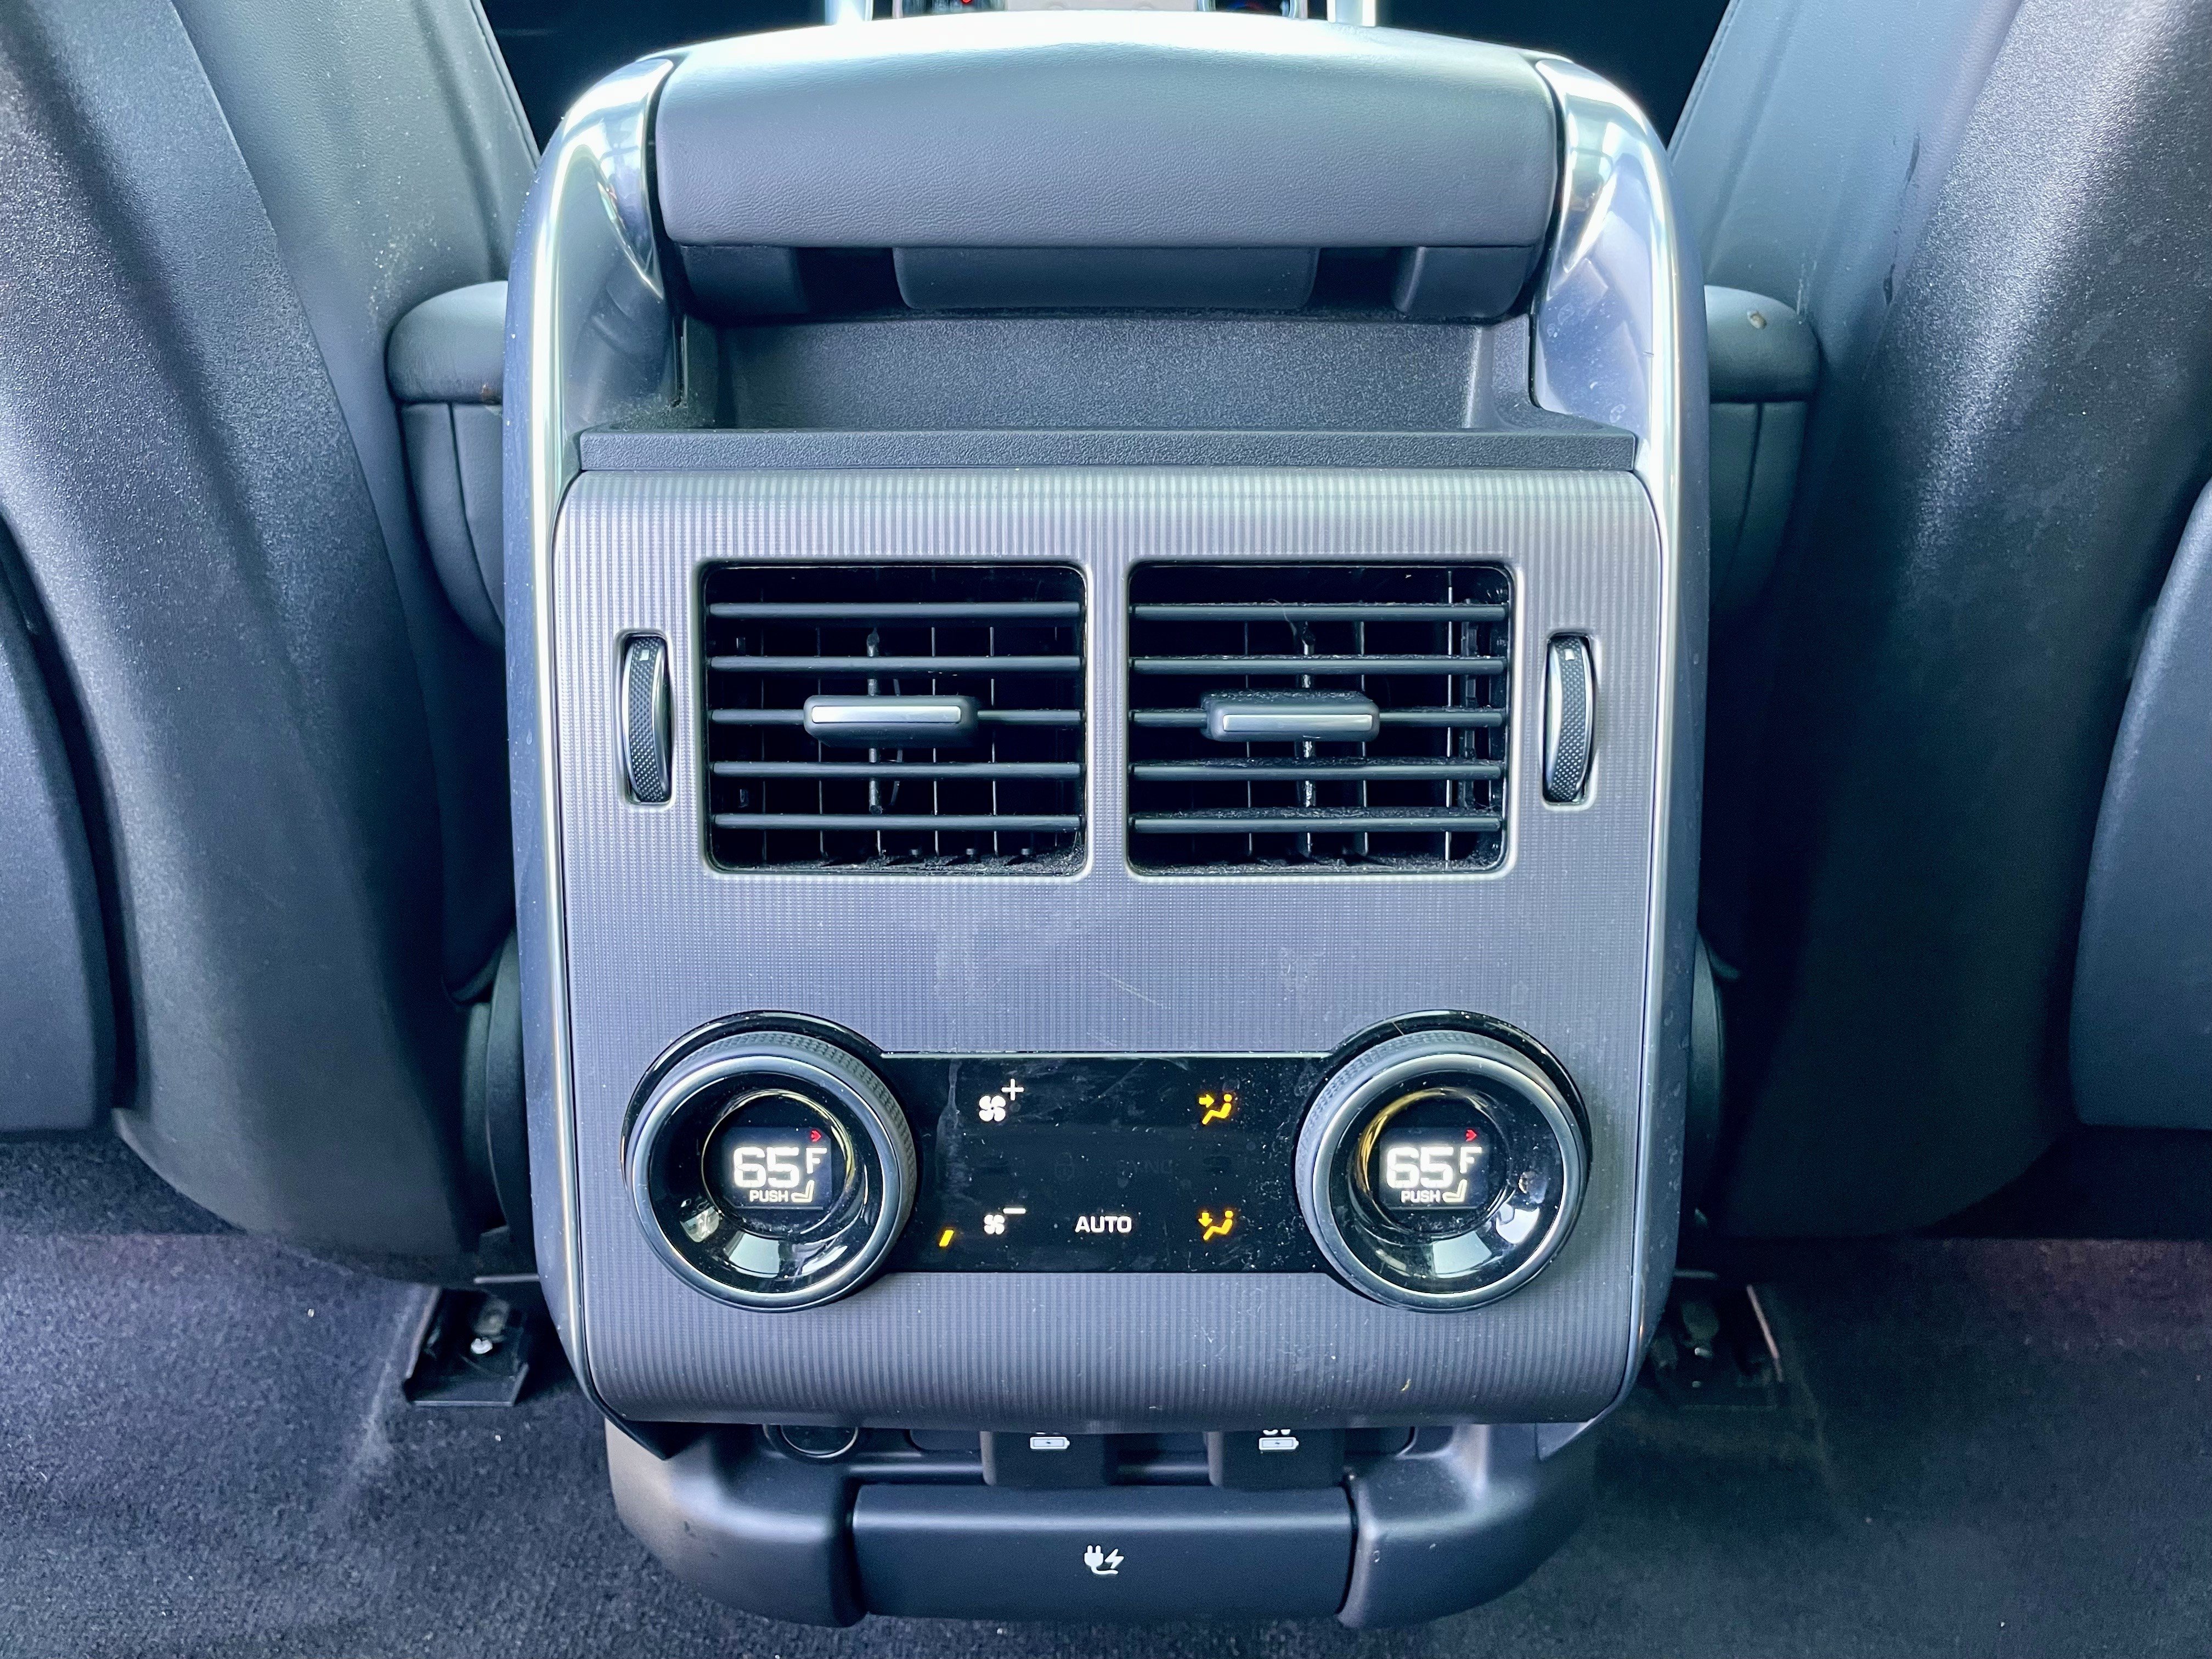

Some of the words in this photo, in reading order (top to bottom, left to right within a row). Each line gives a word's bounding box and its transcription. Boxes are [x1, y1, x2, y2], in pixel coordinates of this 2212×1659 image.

[749, 1189, 789, 1203] PUSH
[1401, 1189, 1441, 1203] PUSH
[1075, 1216, 1132, 1233] AUTO
